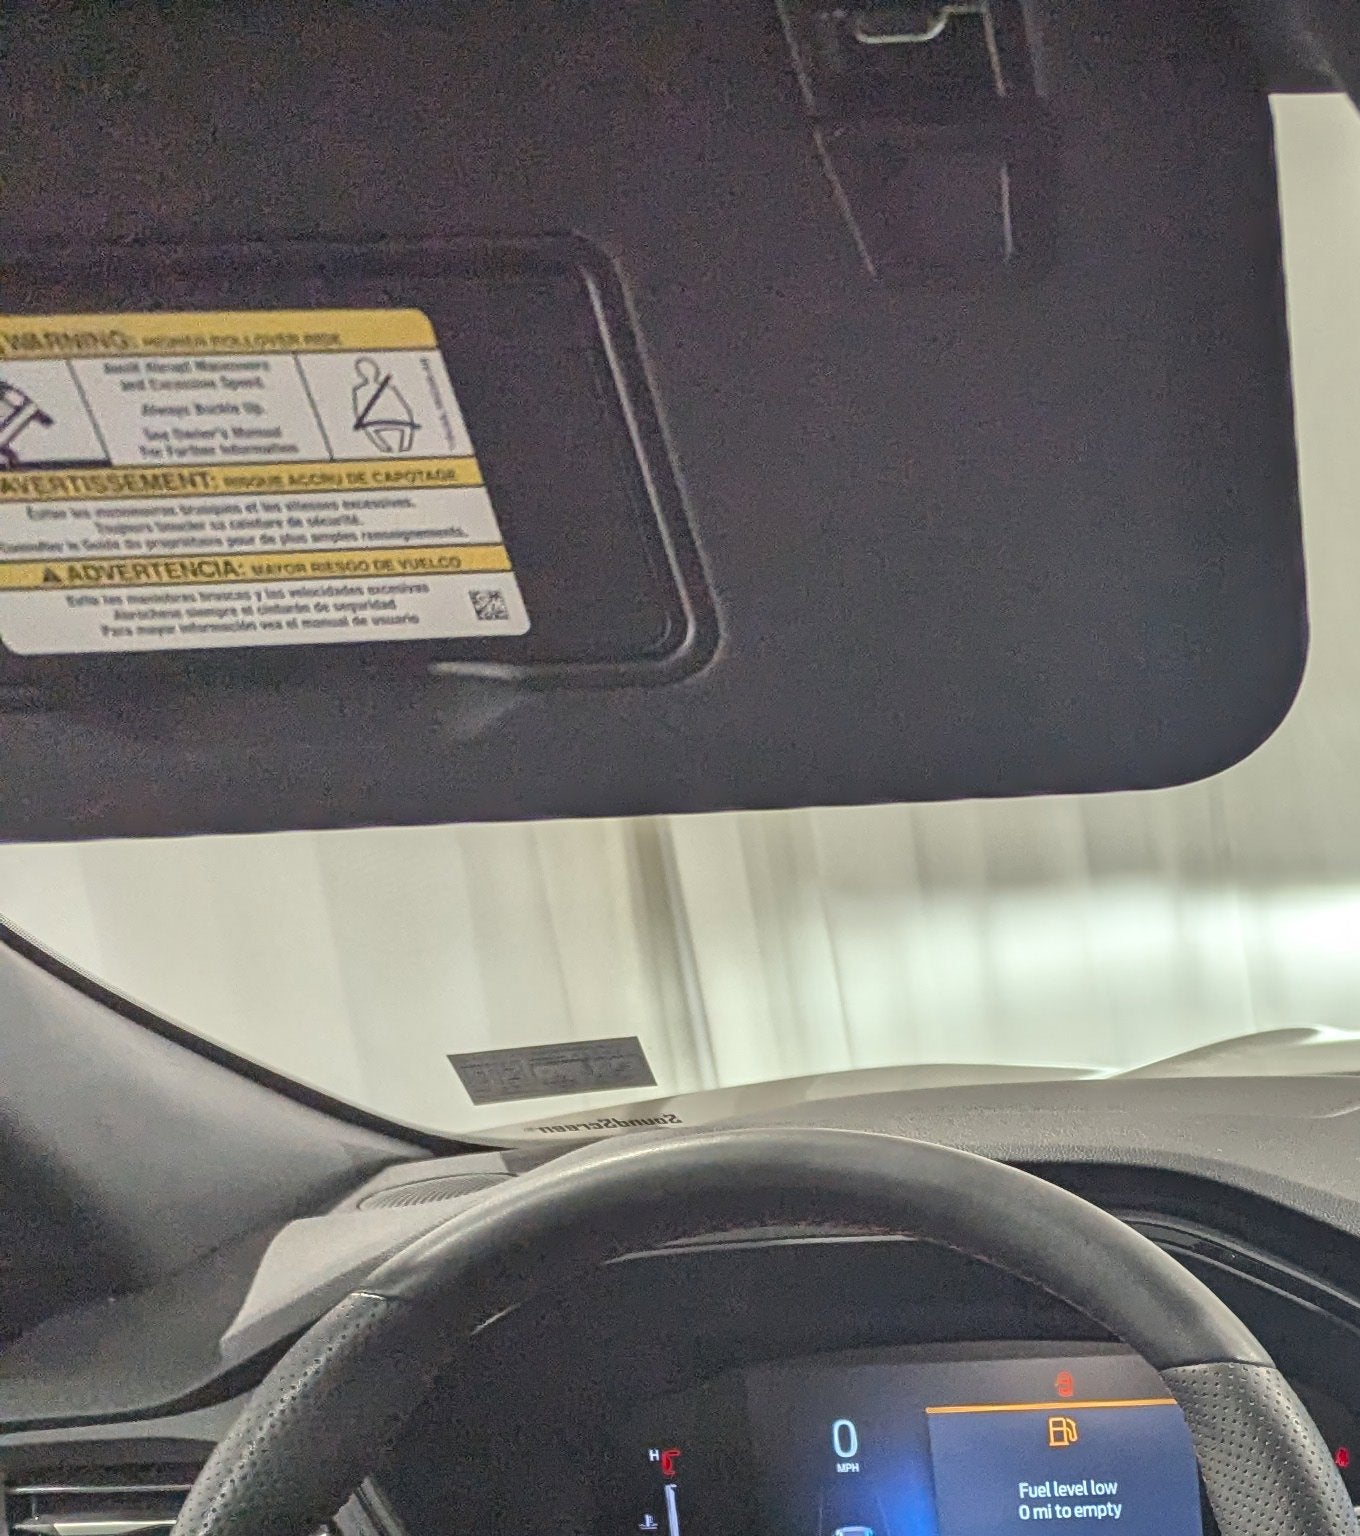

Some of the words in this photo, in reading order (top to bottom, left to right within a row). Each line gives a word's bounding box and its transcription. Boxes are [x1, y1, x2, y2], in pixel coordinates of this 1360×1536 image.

[68, 559, 243, 582] ADVERTENCIA:
[831, 1418, 859, 1459] 0
[649, 1449, 660, 1462] H
[836, 1462, 860, 1474] MPH
[1018, 1481, 1052, 1499] Fuel
[1053, 1480, 1089, 1497] level
[1090, 1479, 1119, 1496] low
[1018, 1504, 1031, 1521] 0
[1033, 1503, 1053, 1520] mi
[1054, 1503, 1072, 1520] to
[1073, 1501, 1123, 1520] empty
